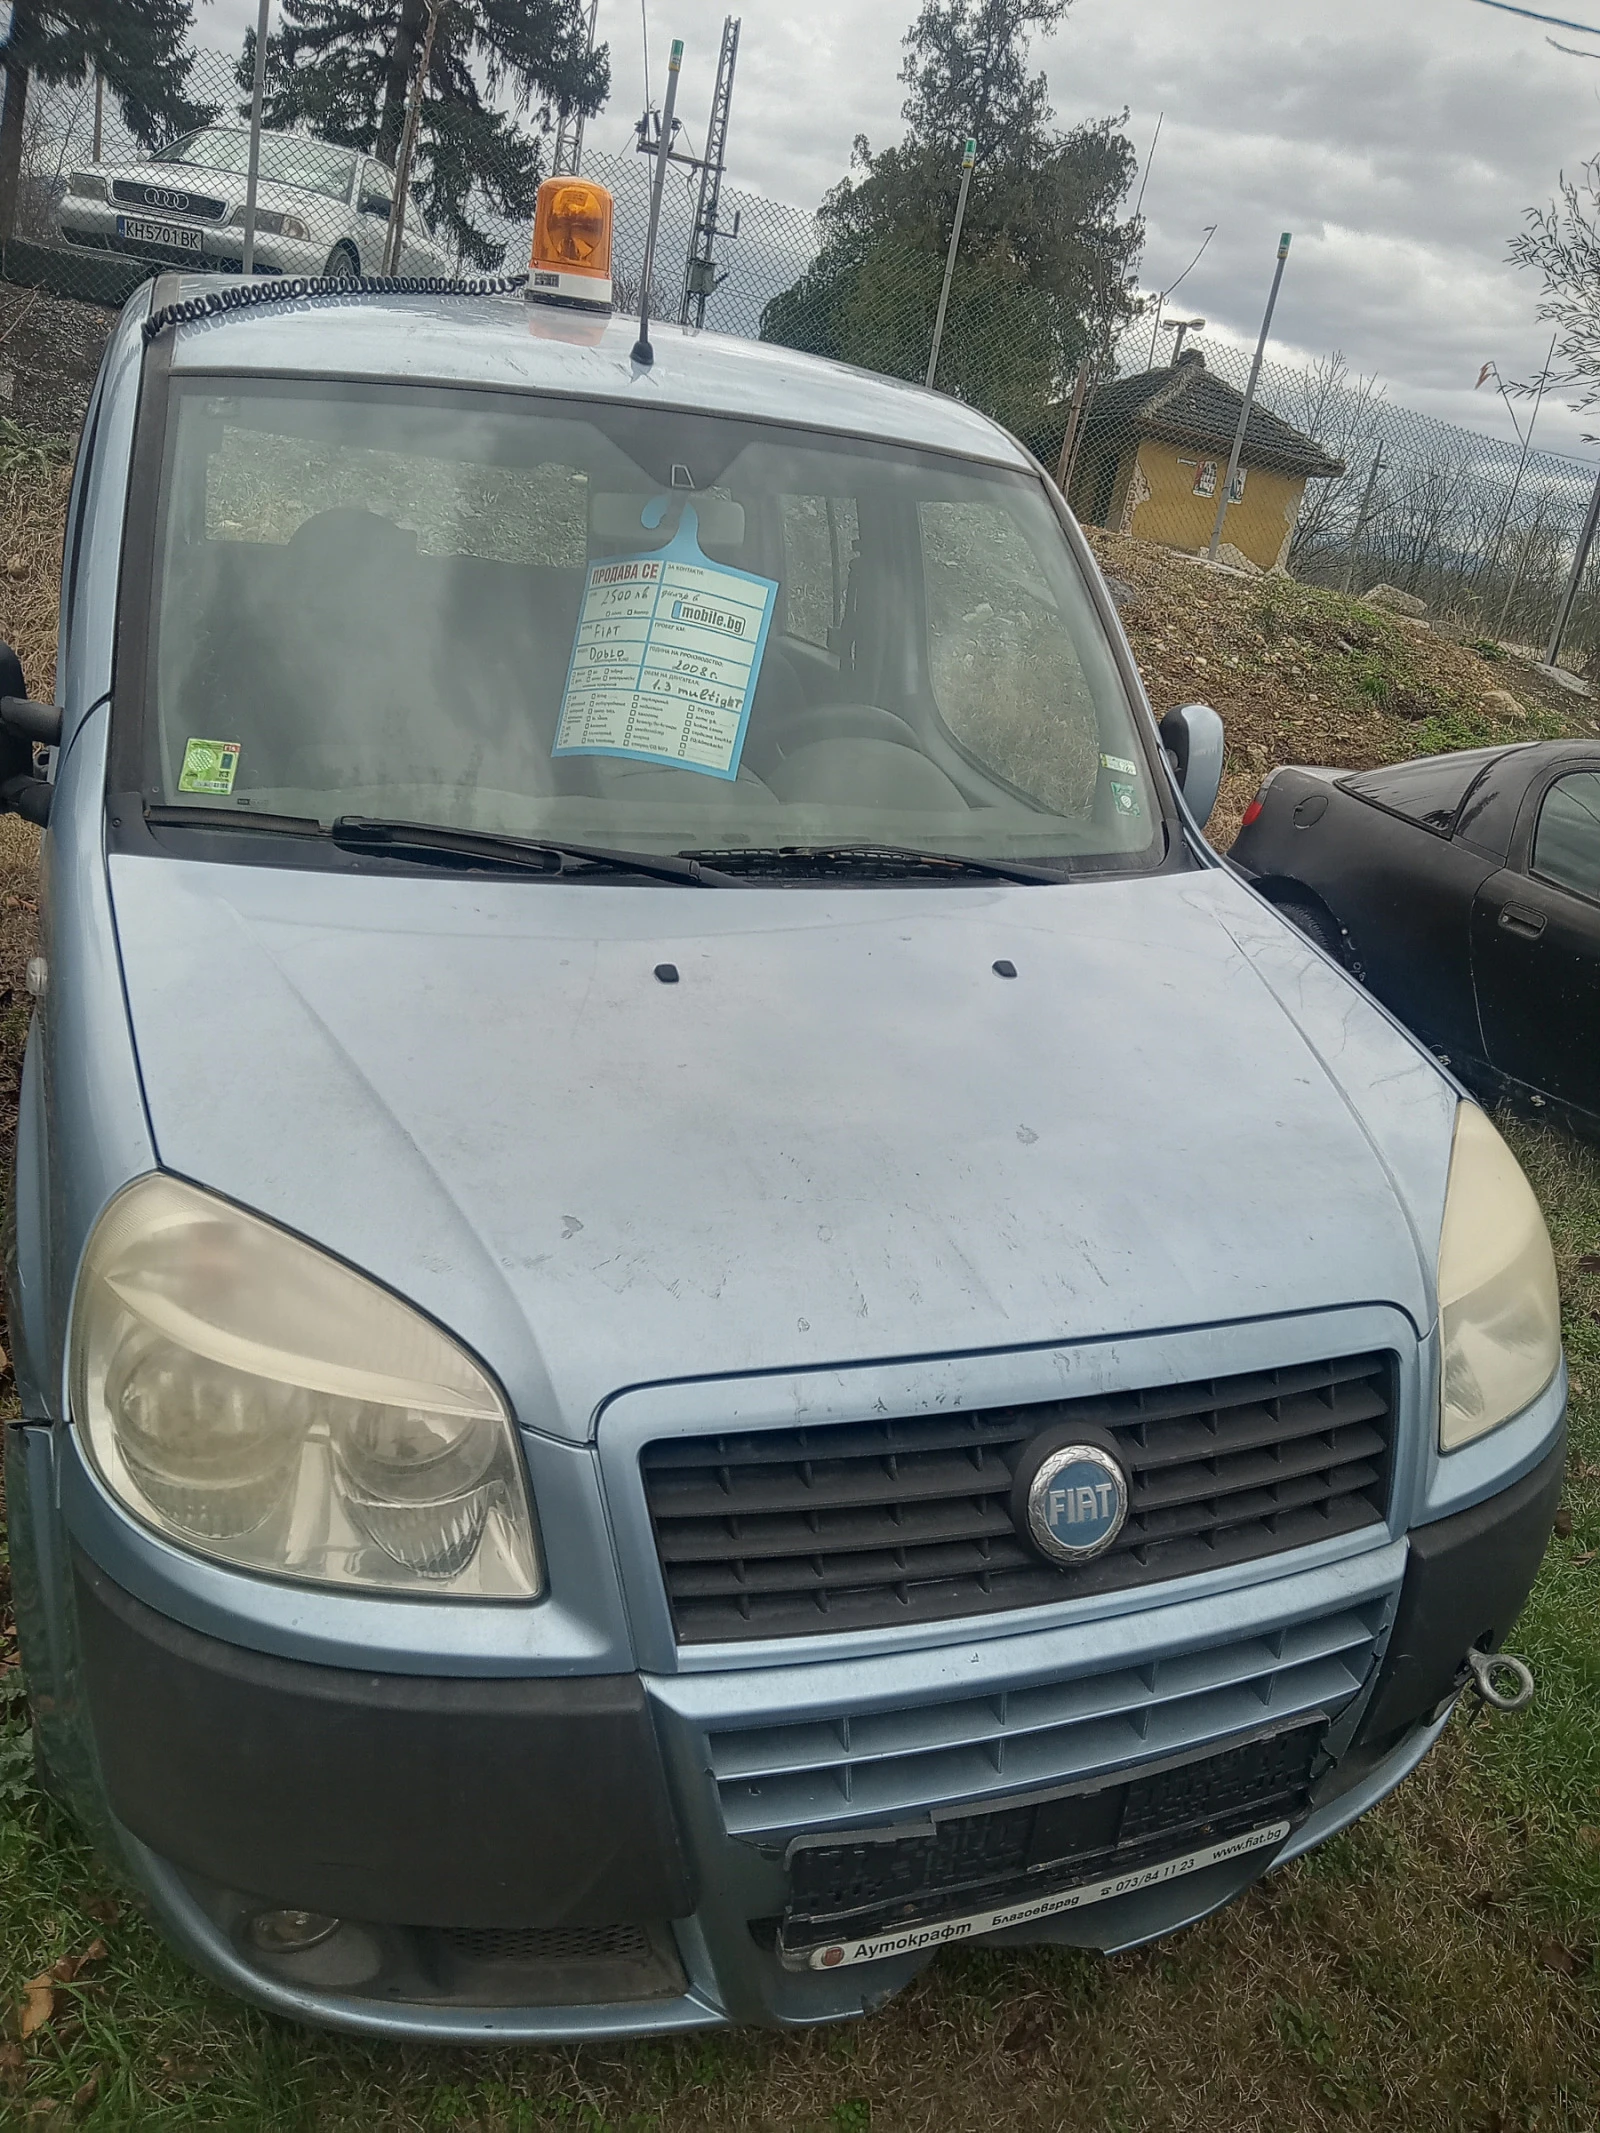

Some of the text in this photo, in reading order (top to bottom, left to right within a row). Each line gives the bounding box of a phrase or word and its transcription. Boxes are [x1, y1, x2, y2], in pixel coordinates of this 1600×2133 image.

[592, 563, 659, 585] ПРОДАВА СЕ
[682, 606, 743, 633] mobile.bg
[1048, 1483, 1112, 1526] FIAT
[853, 1827, 1282, 1960] Аутокрафт Благоевград 073/84 11 23 www.fiat.bg
